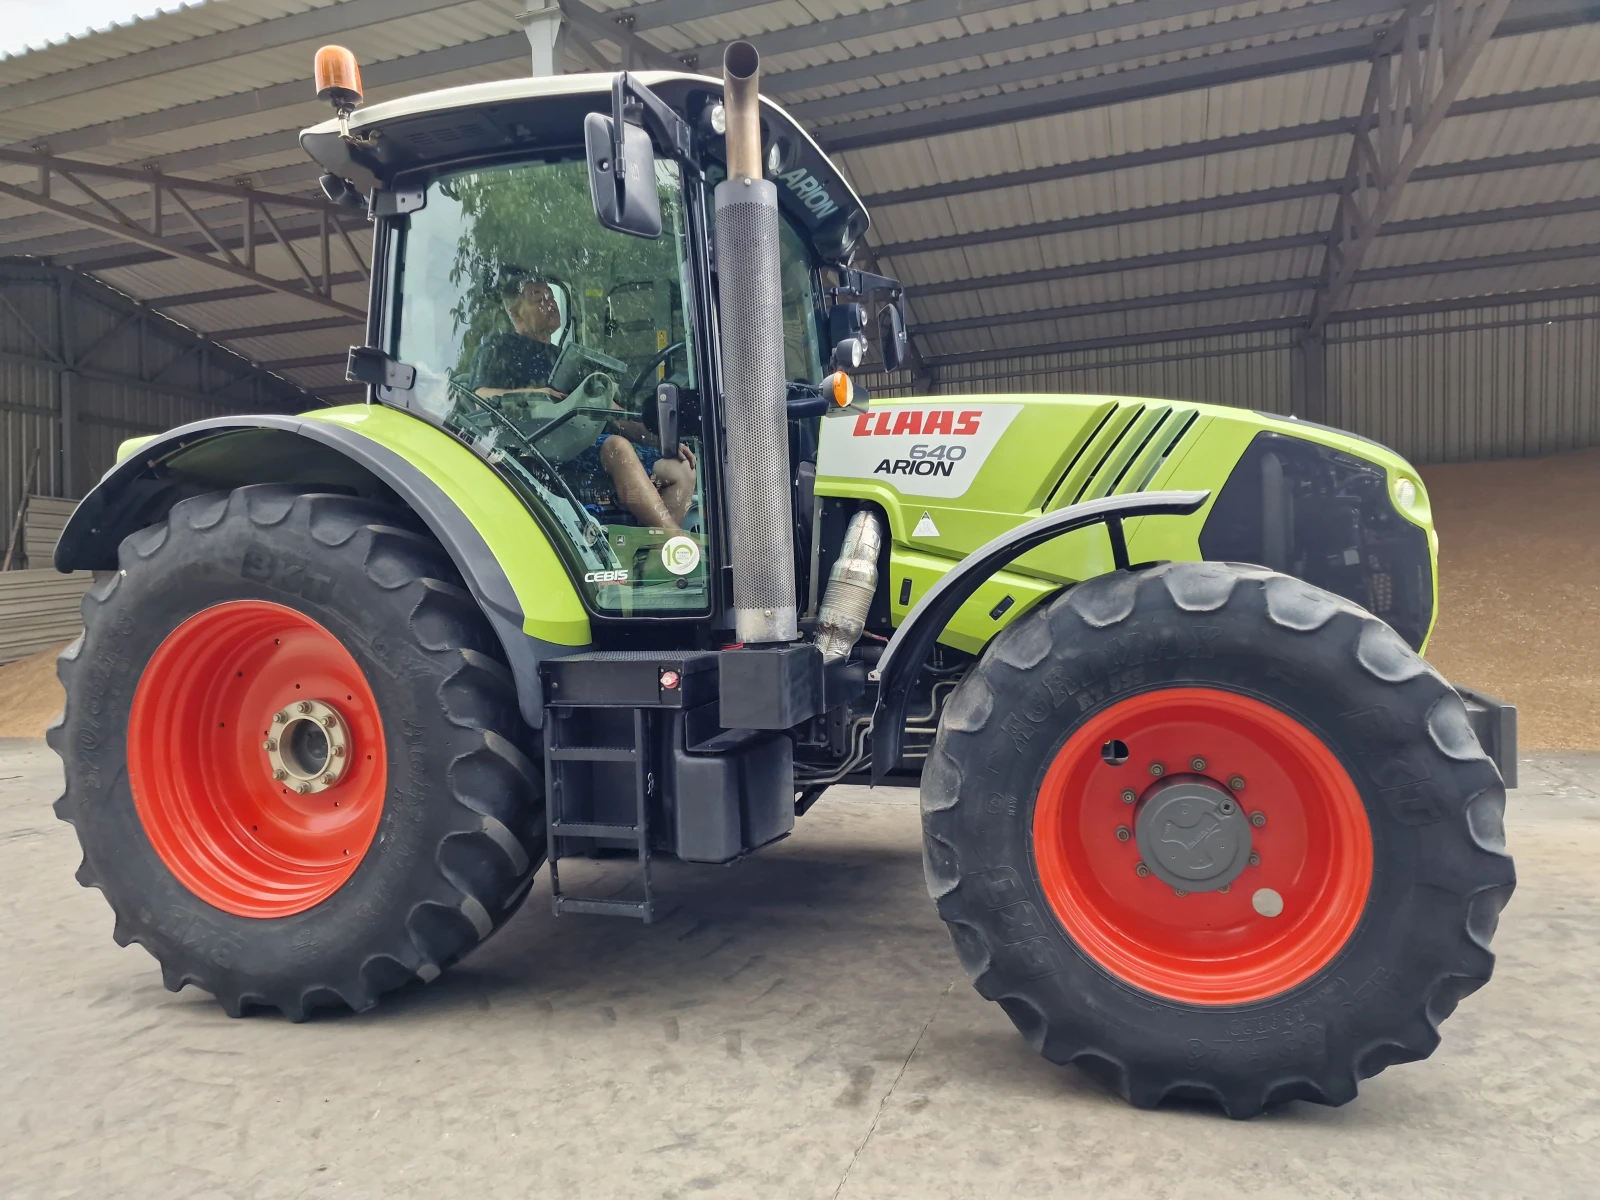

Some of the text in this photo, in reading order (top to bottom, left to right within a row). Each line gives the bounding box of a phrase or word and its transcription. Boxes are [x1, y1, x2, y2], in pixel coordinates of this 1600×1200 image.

[778, 168, 839, 219] ARION
[853, 411, 983, 436] CLAAS
[909, 444, 967, 461] 640
[873, 459, 955, 477] ARION
[584, 569, 629, 583] CEBIS
